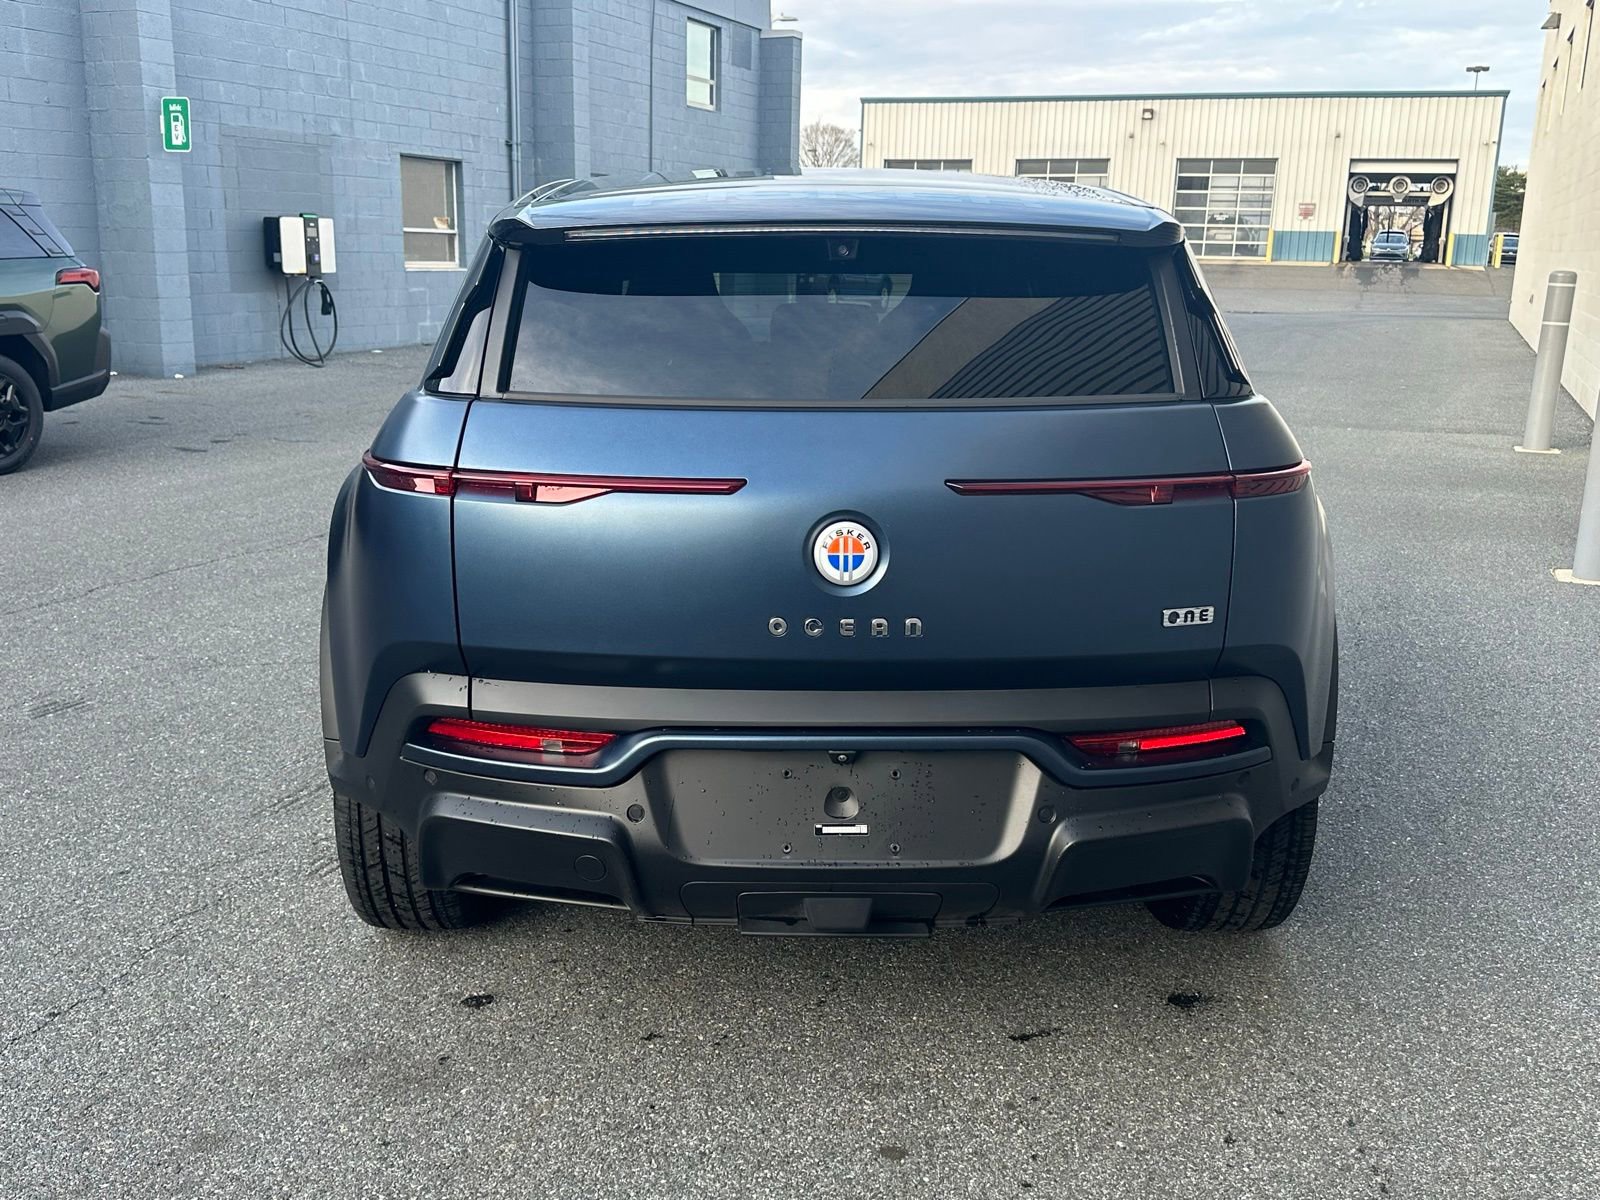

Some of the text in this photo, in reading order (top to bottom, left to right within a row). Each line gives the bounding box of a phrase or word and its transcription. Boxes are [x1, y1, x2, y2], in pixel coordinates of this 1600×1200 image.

[822, 529, 871, 550] FISKER
[768, 616, 924, 638] OCEAN
[1168, 608, 1210, 625] ONE
